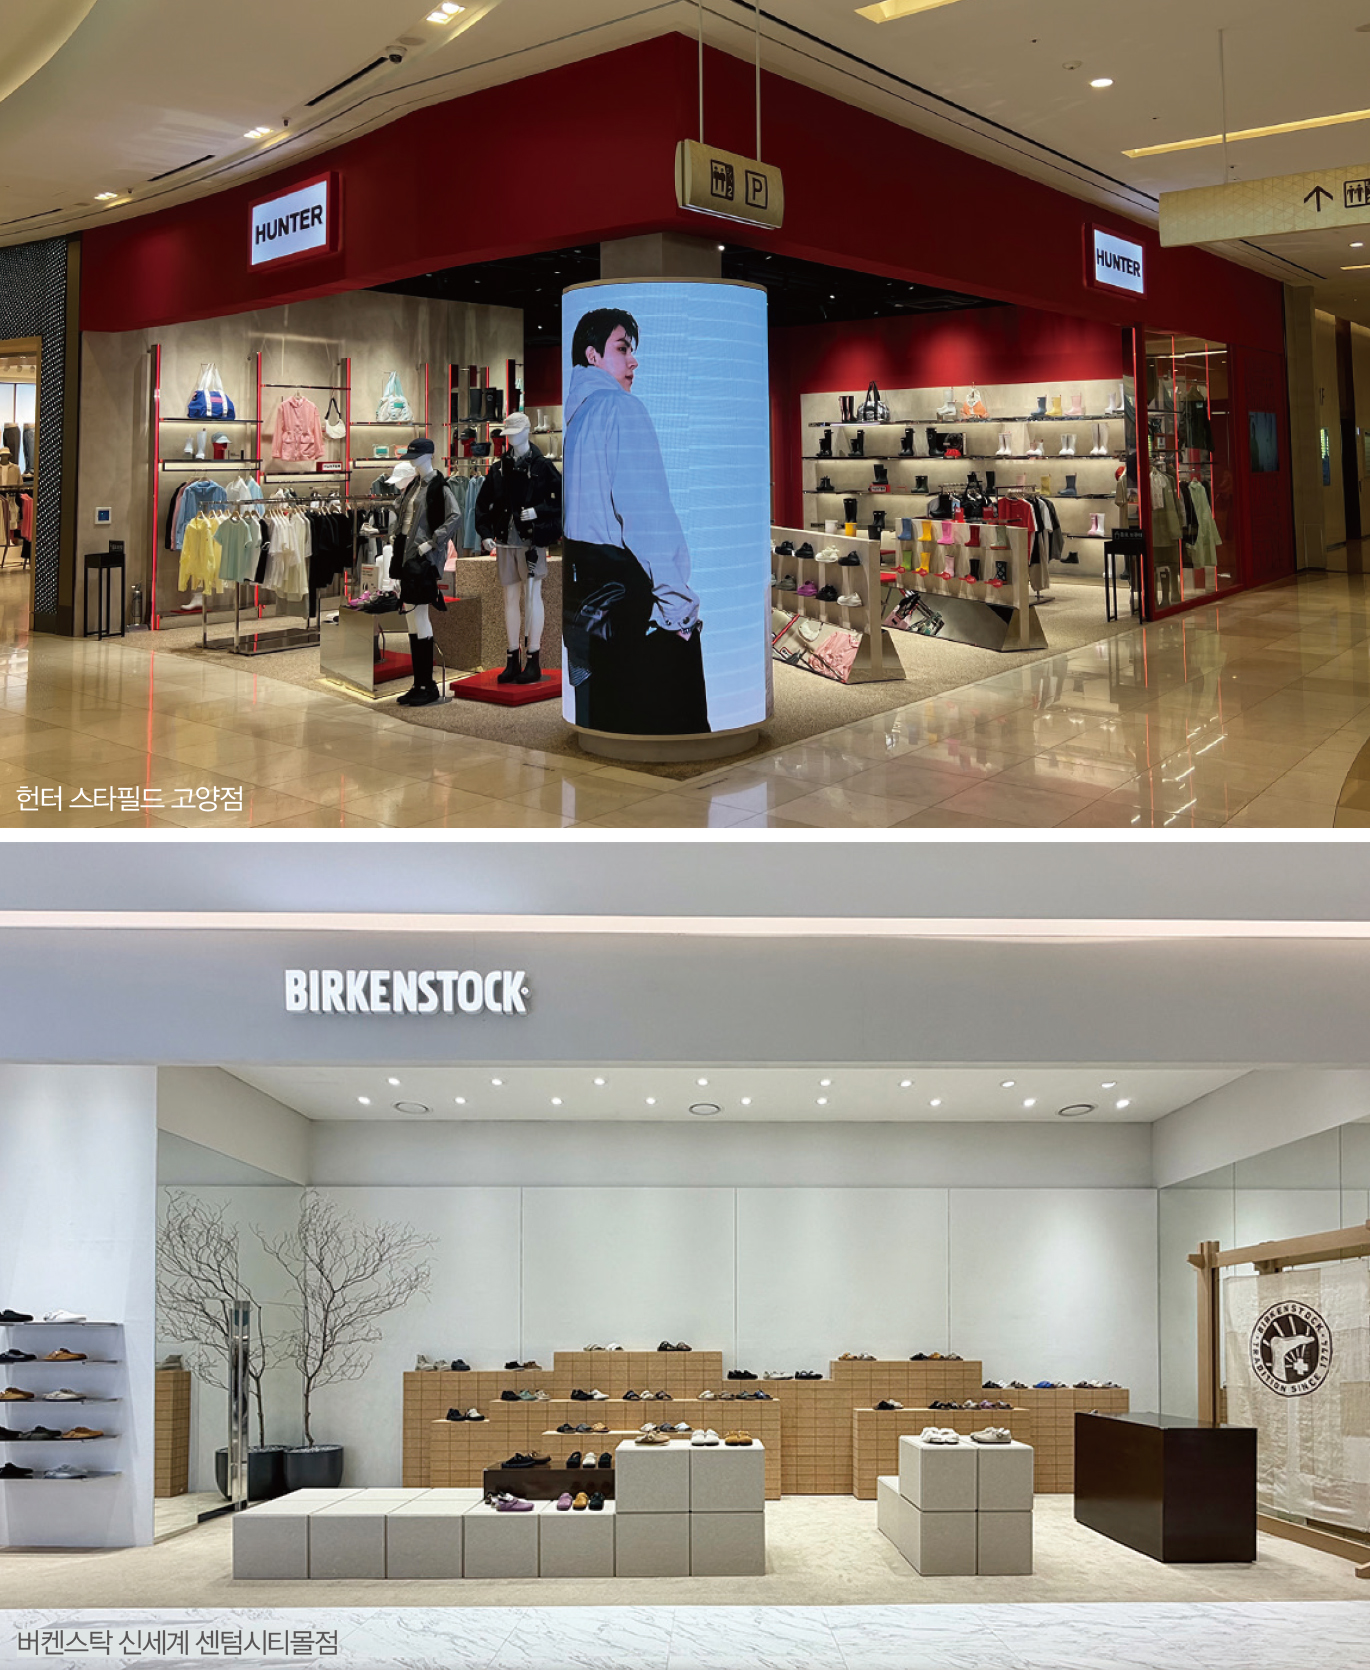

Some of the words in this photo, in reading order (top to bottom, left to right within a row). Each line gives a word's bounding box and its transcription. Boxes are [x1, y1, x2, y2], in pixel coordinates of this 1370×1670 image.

[752, 177, 763, 201] P
[255, 204, 323, 245] HUNTER
[1096, 247, 1141, 277] HUNTER
[285, 969, 526, 1015] BIRKENSTOCK
[1258, 1304, 1324, 1333] BIRKENSTOCK
[1253, 1342, 1286, 1392] TRADITION
[1291, 1373, 1321, 1393] SINCE
